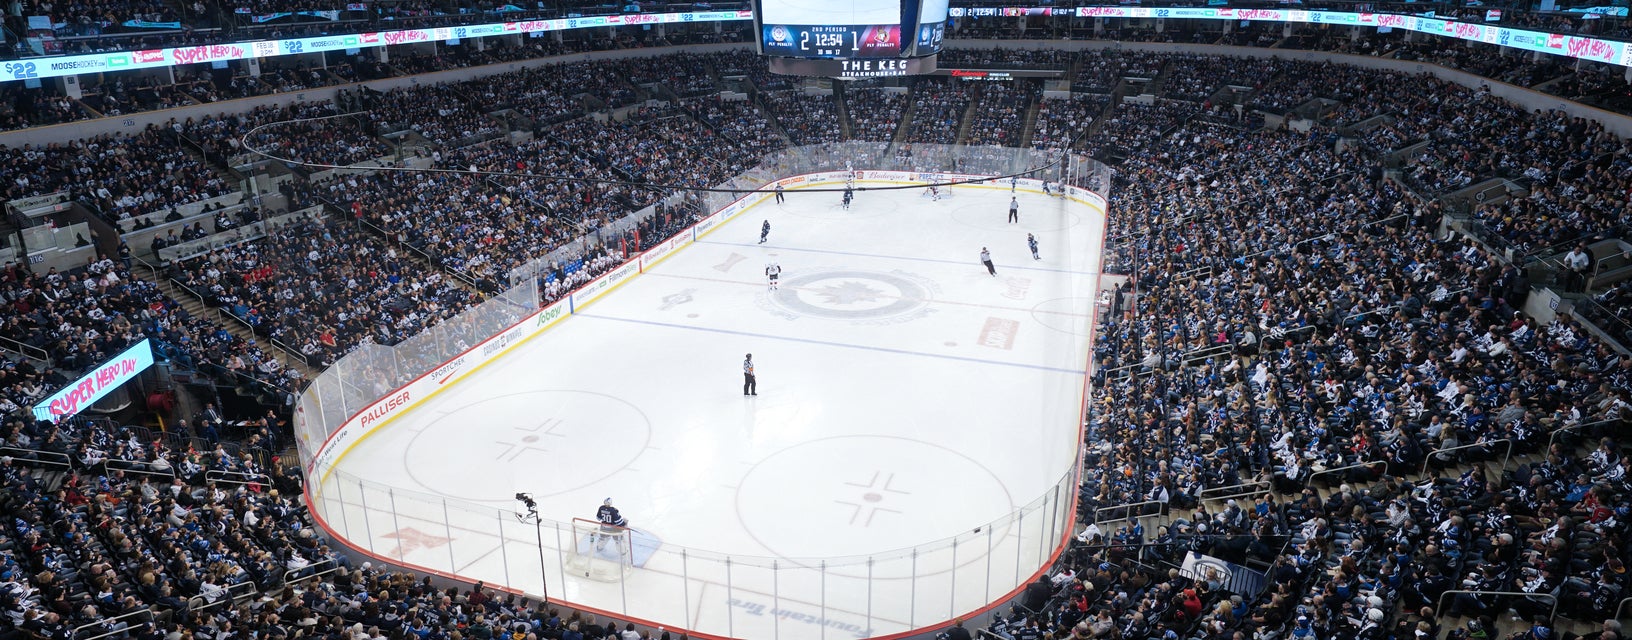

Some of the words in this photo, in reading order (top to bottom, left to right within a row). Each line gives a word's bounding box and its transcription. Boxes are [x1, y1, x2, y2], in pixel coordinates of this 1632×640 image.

[284, 41, 303, 53] $22
[800, 31, 809, 50] 2
[815, 34, 843, 46] 12:54
[851, 31, 859, 50] 1
[173, 46, 208, 64] SUPER
[210, 46, 229, 59] HERO
[231, 46, 244, 59] DAY
[5, 61, 38, 79] $22
[841, 61, 870, 70] THE
[878, 60, 907, 70] KEG
[30, 255, 44, 265] 116
[431, 356, 465, 381] SPORTCHEK
[50, 376, 95, 418] SUPER
[95, 362, 121, 391] HERO
[121, 358, 137, 377] DAY
[360, 391, 410, 428] PALLISER
[601, 513, 612, 523] 30
